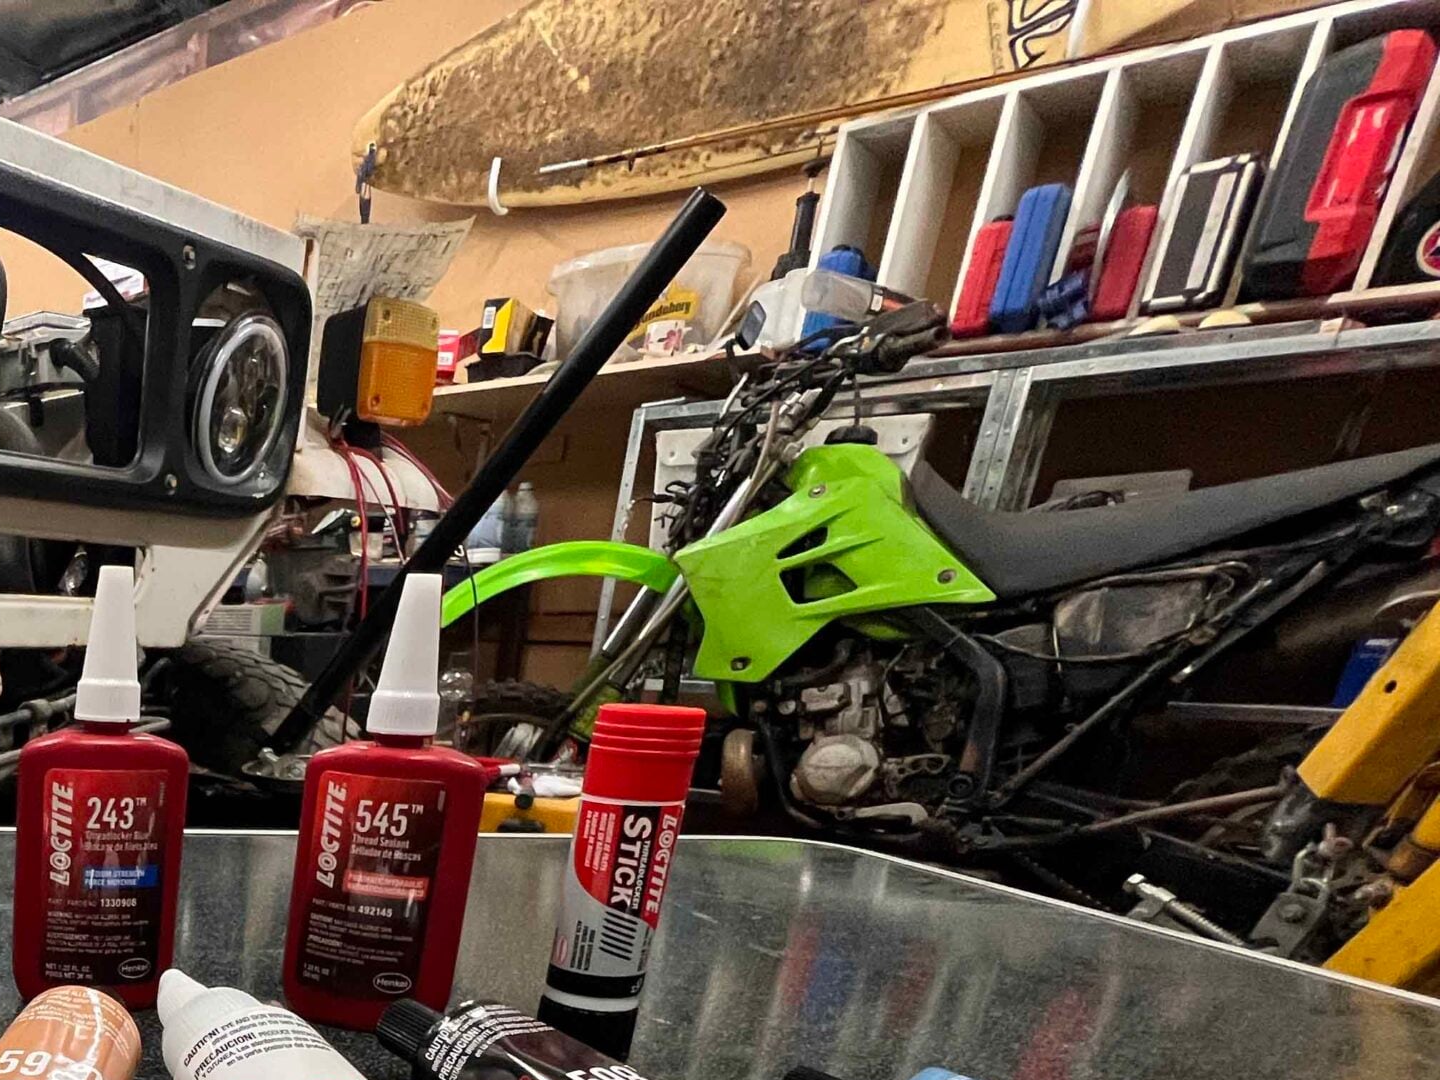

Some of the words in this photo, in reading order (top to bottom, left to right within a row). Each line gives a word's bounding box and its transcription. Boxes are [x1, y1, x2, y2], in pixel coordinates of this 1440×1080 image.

[49, 782, 74, 886] LOCTITE
[316, 781, 347, 888] LOCTITE
[351, 845, 381, 857] Sellador
[394, 851, 421, 861] Roscas
[353, 834, 378, 846] Thread
[380, 837, 410, 850] Sealant
[610, 814, 652, 914] STICK
[632, 840, 651, 910] THREADLOCKER
[646, 814, 678, 914] LOCTITE
[121, 963, 148, 973] Henkel
[376, 978, 408, 989] Henkel
[221, 1022, 234, 1032] EYE
[235, 1016, 250, 1026] AND
